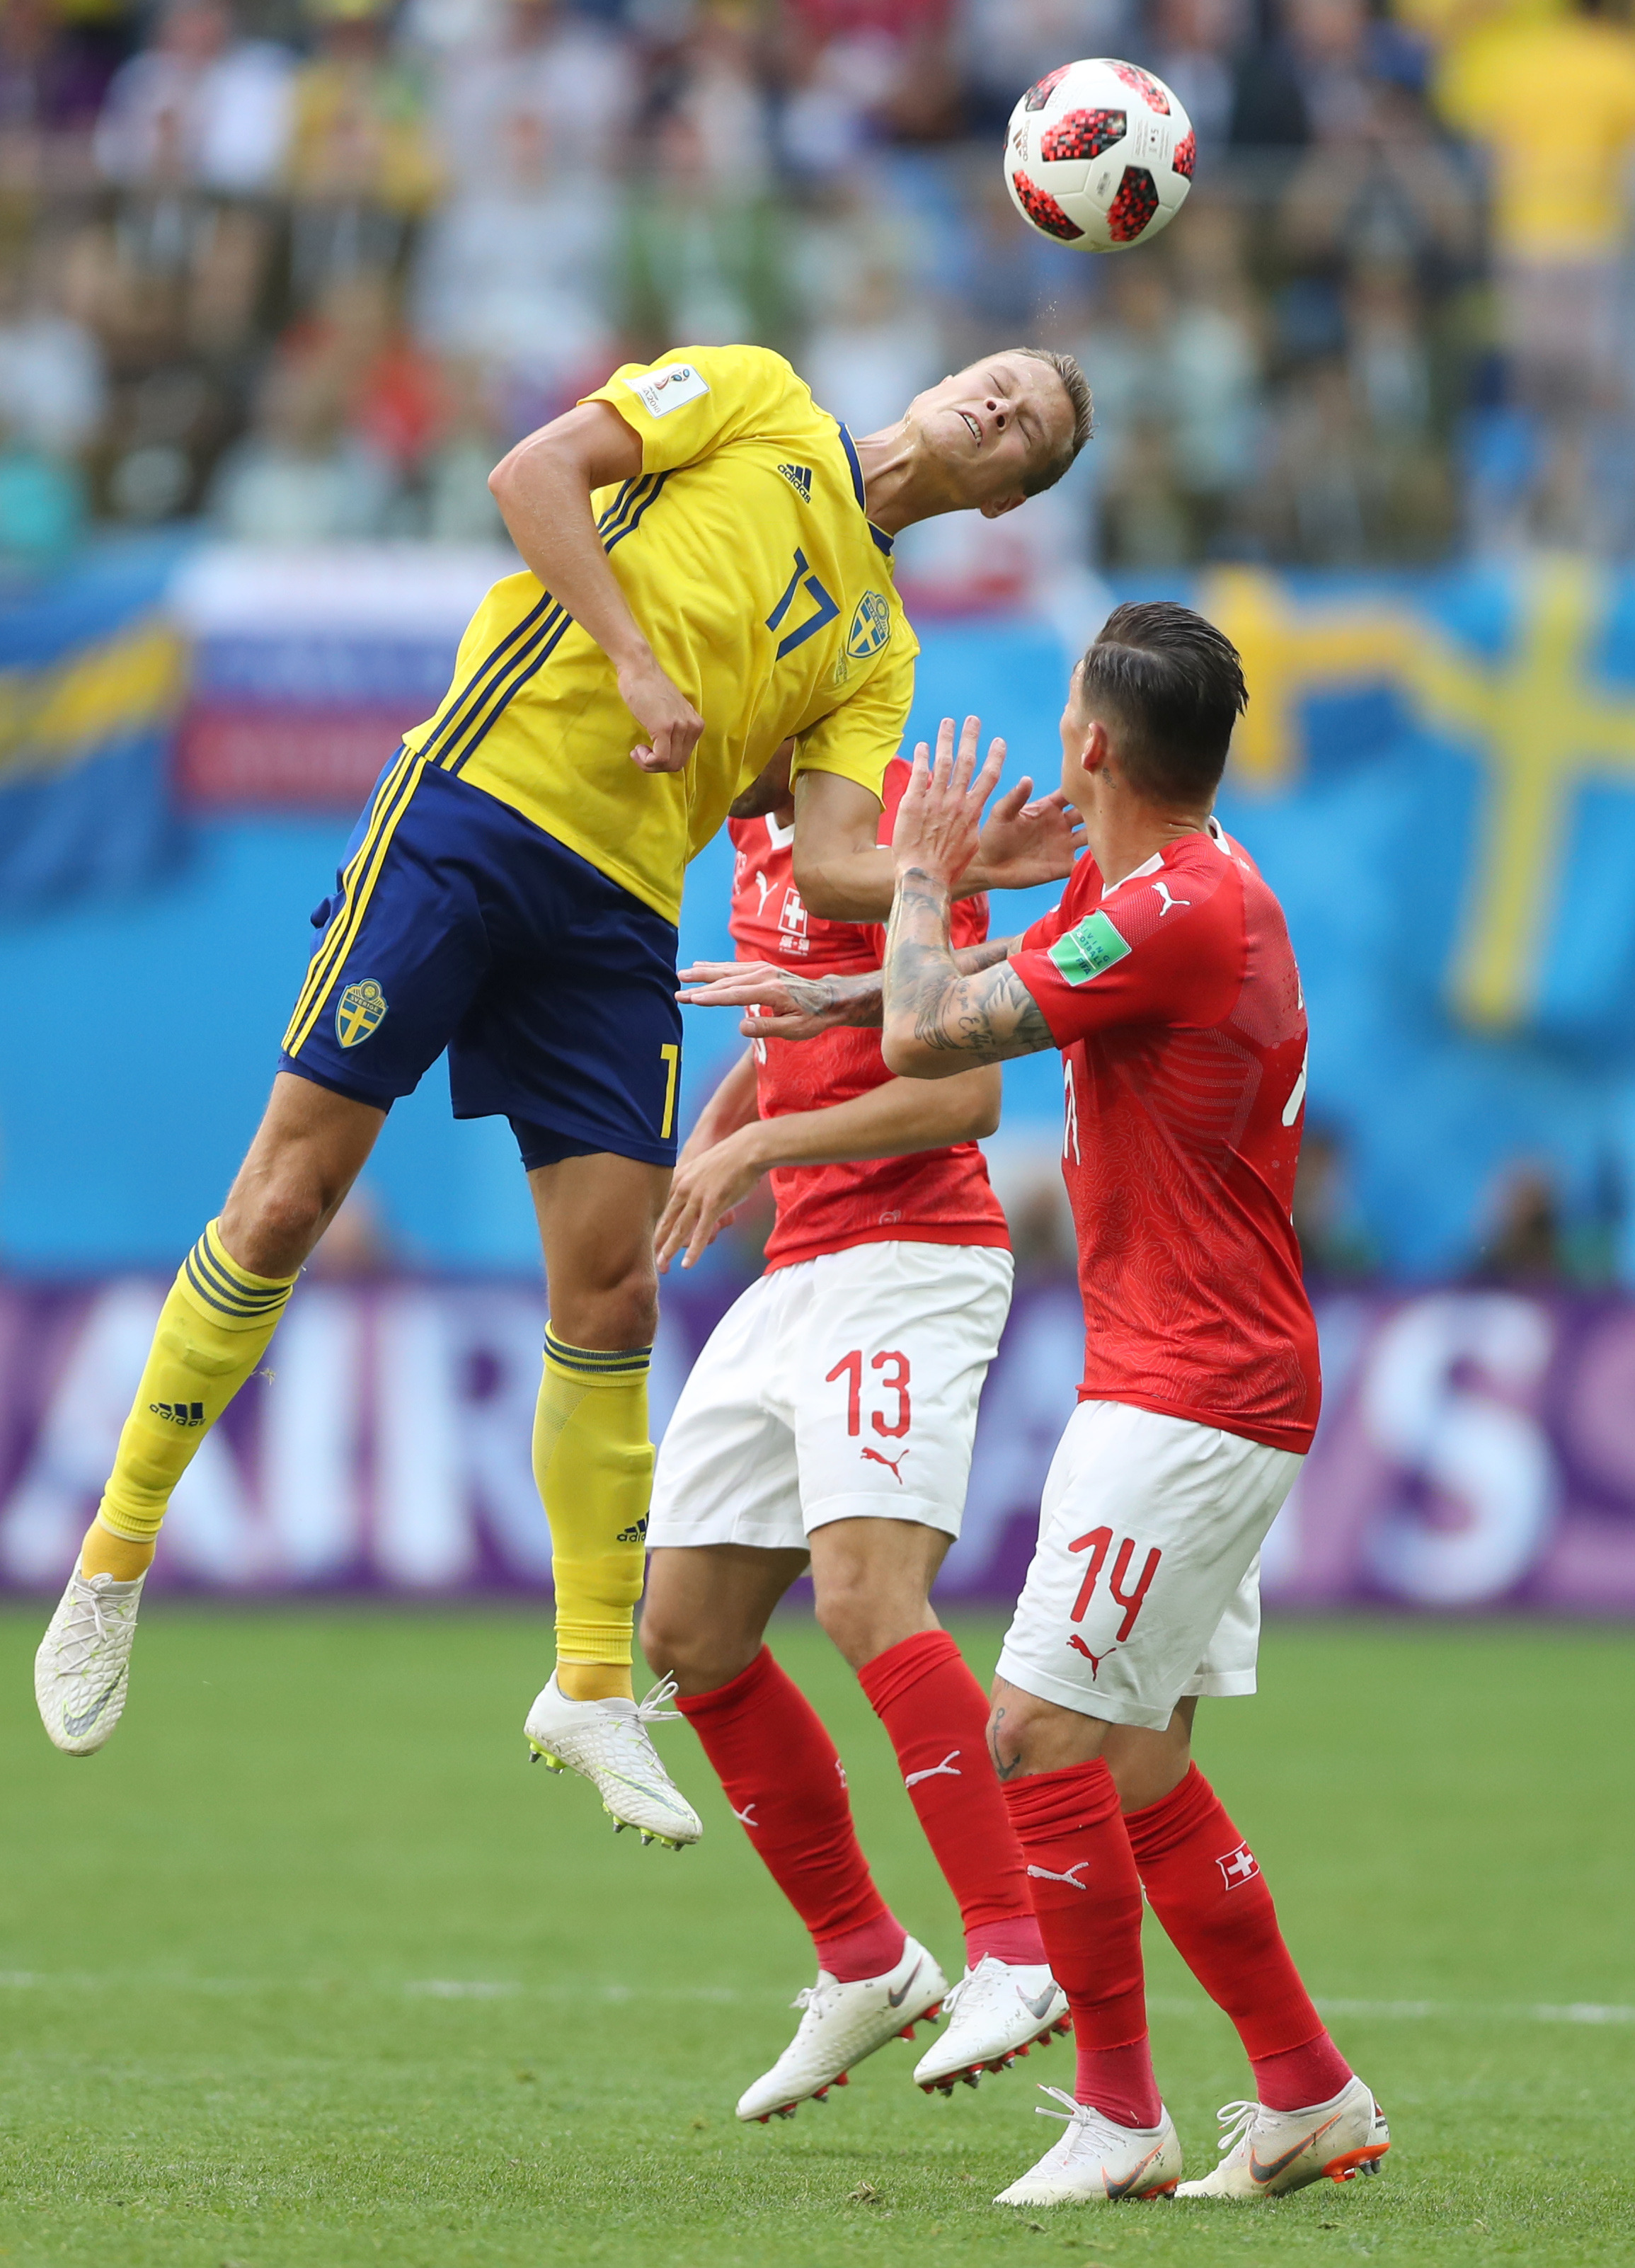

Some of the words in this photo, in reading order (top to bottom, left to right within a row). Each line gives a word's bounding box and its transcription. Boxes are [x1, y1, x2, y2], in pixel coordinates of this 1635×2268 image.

[777, 464, 812, 504] adidas
[764, 546, 841, 663] 17
[1081, 924, 1109, 962] LIVING
[1076, 957, 1091, 975] FIFA
[350, 995, 379, 1013] SVERIGE
[660, 1043, 684, 1139] 1
[825, 1349, 911, 1438] 13
[149, 1404, 207, 1427] adidas
[1067, 1525, 1162, 1643] 14
